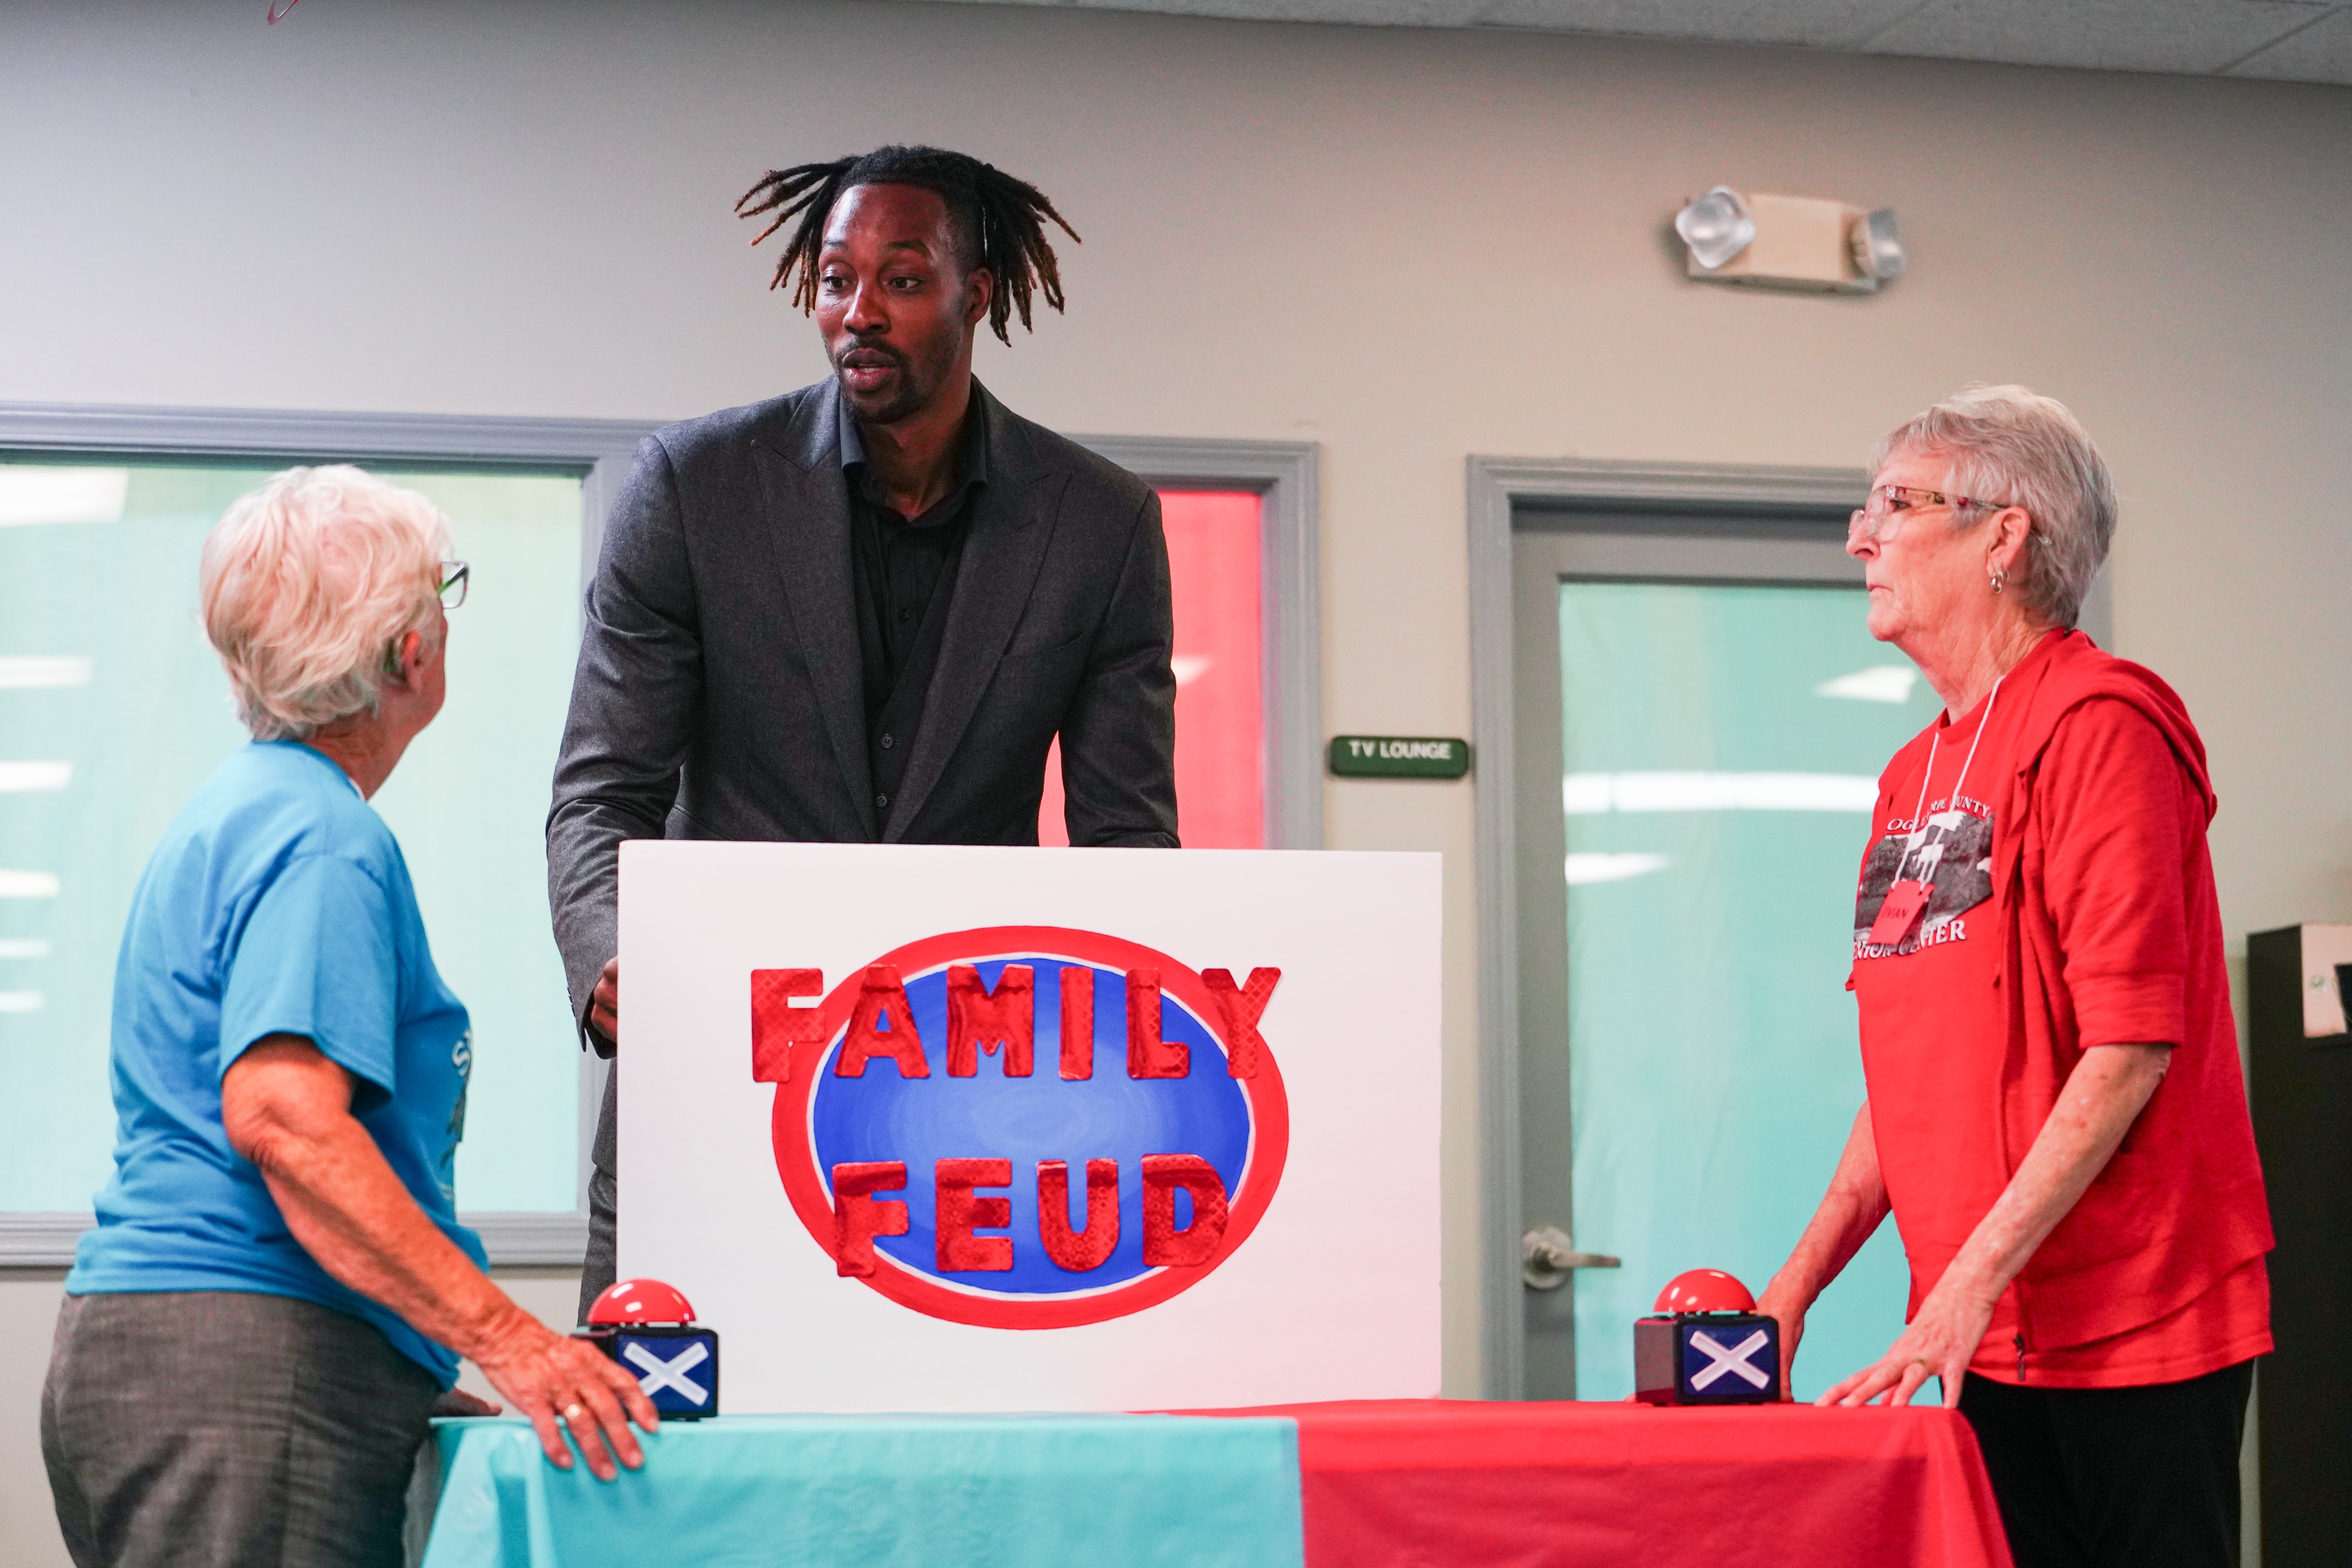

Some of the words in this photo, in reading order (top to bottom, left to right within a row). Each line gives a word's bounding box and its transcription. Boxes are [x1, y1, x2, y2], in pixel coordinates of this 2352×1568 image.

[1349, 741, 1376, 758] TV
[1380, 741, 1452, 760] LOUNGE
[1949, 796, 1990, 818] UNTY
[750, 963, 1281, 1084] FAMILY
[832, 1154, 1229, 1277] FEUD
